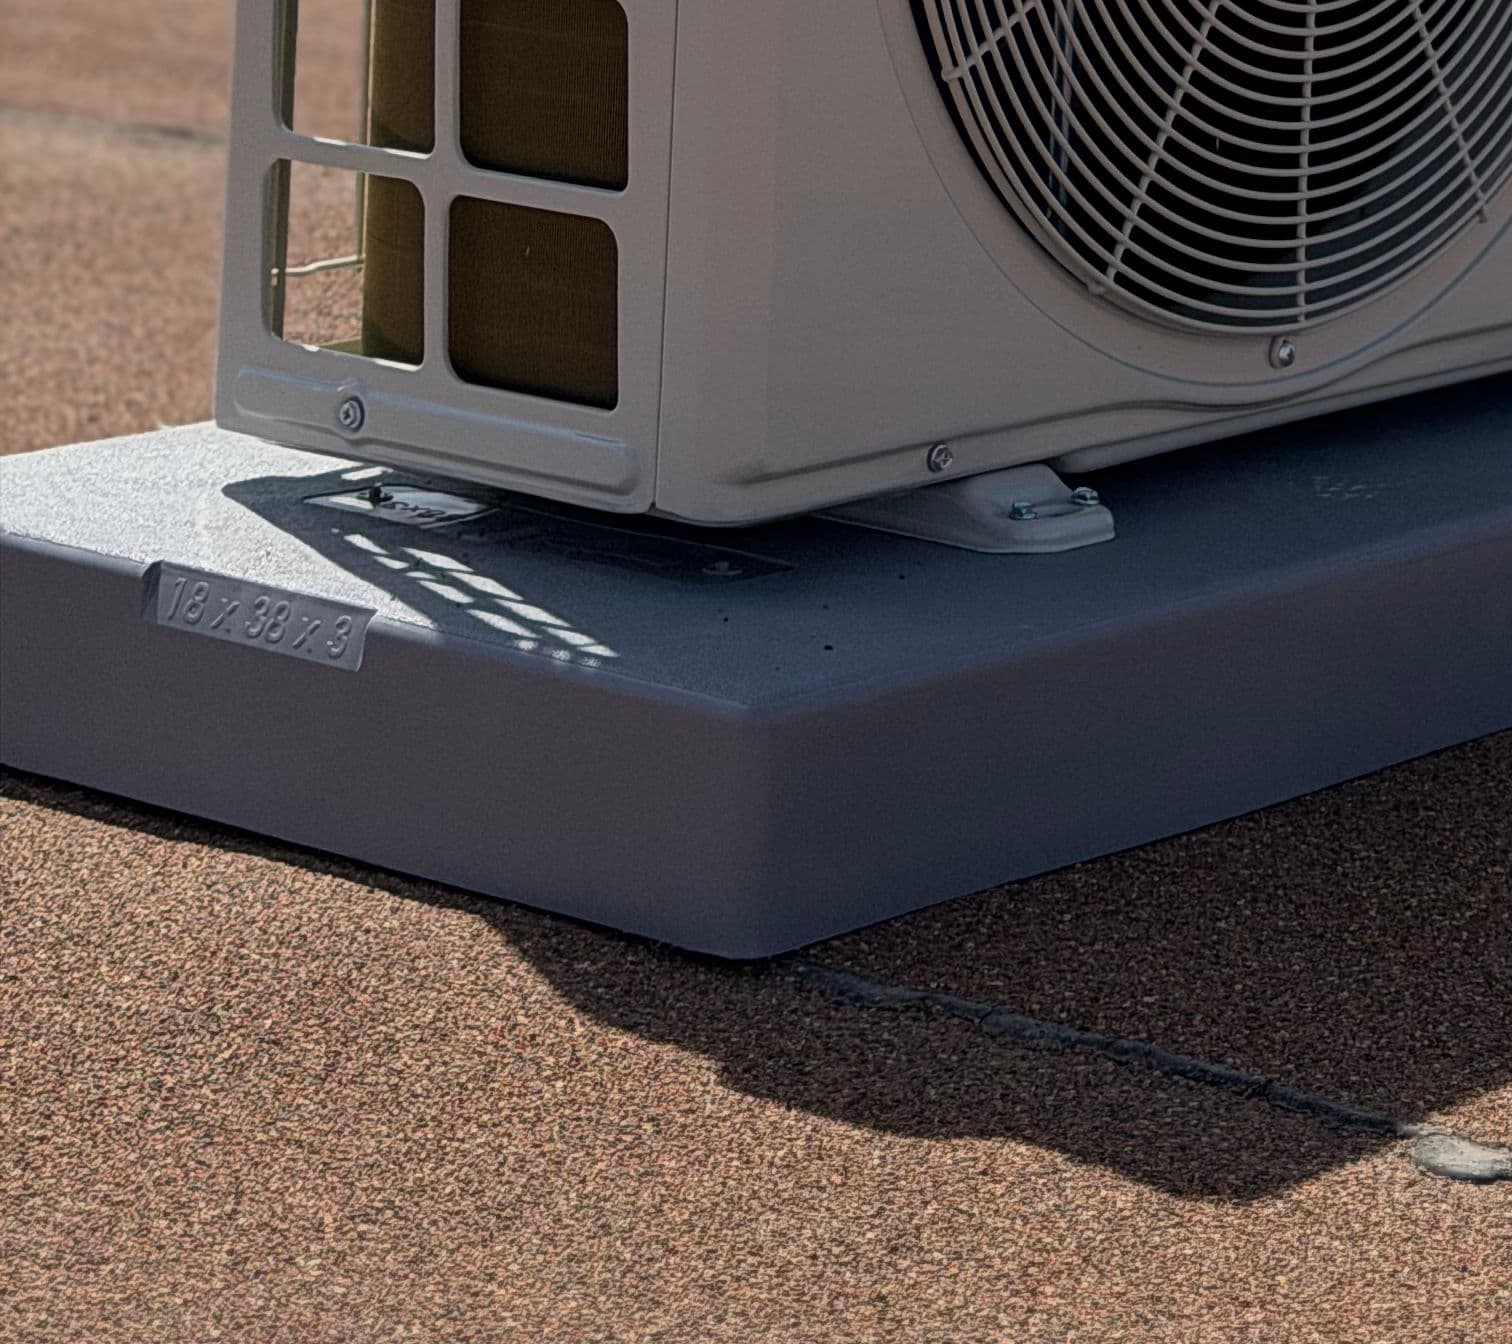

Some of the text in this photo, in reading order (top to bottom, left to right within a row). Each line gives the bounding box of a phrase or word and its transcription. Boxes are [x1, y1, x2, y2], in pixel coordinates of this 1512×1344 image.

[168, 577, 209, 625] 18
[245, 595, 290, 644] 38
[327, 615, 351, 658] 3
